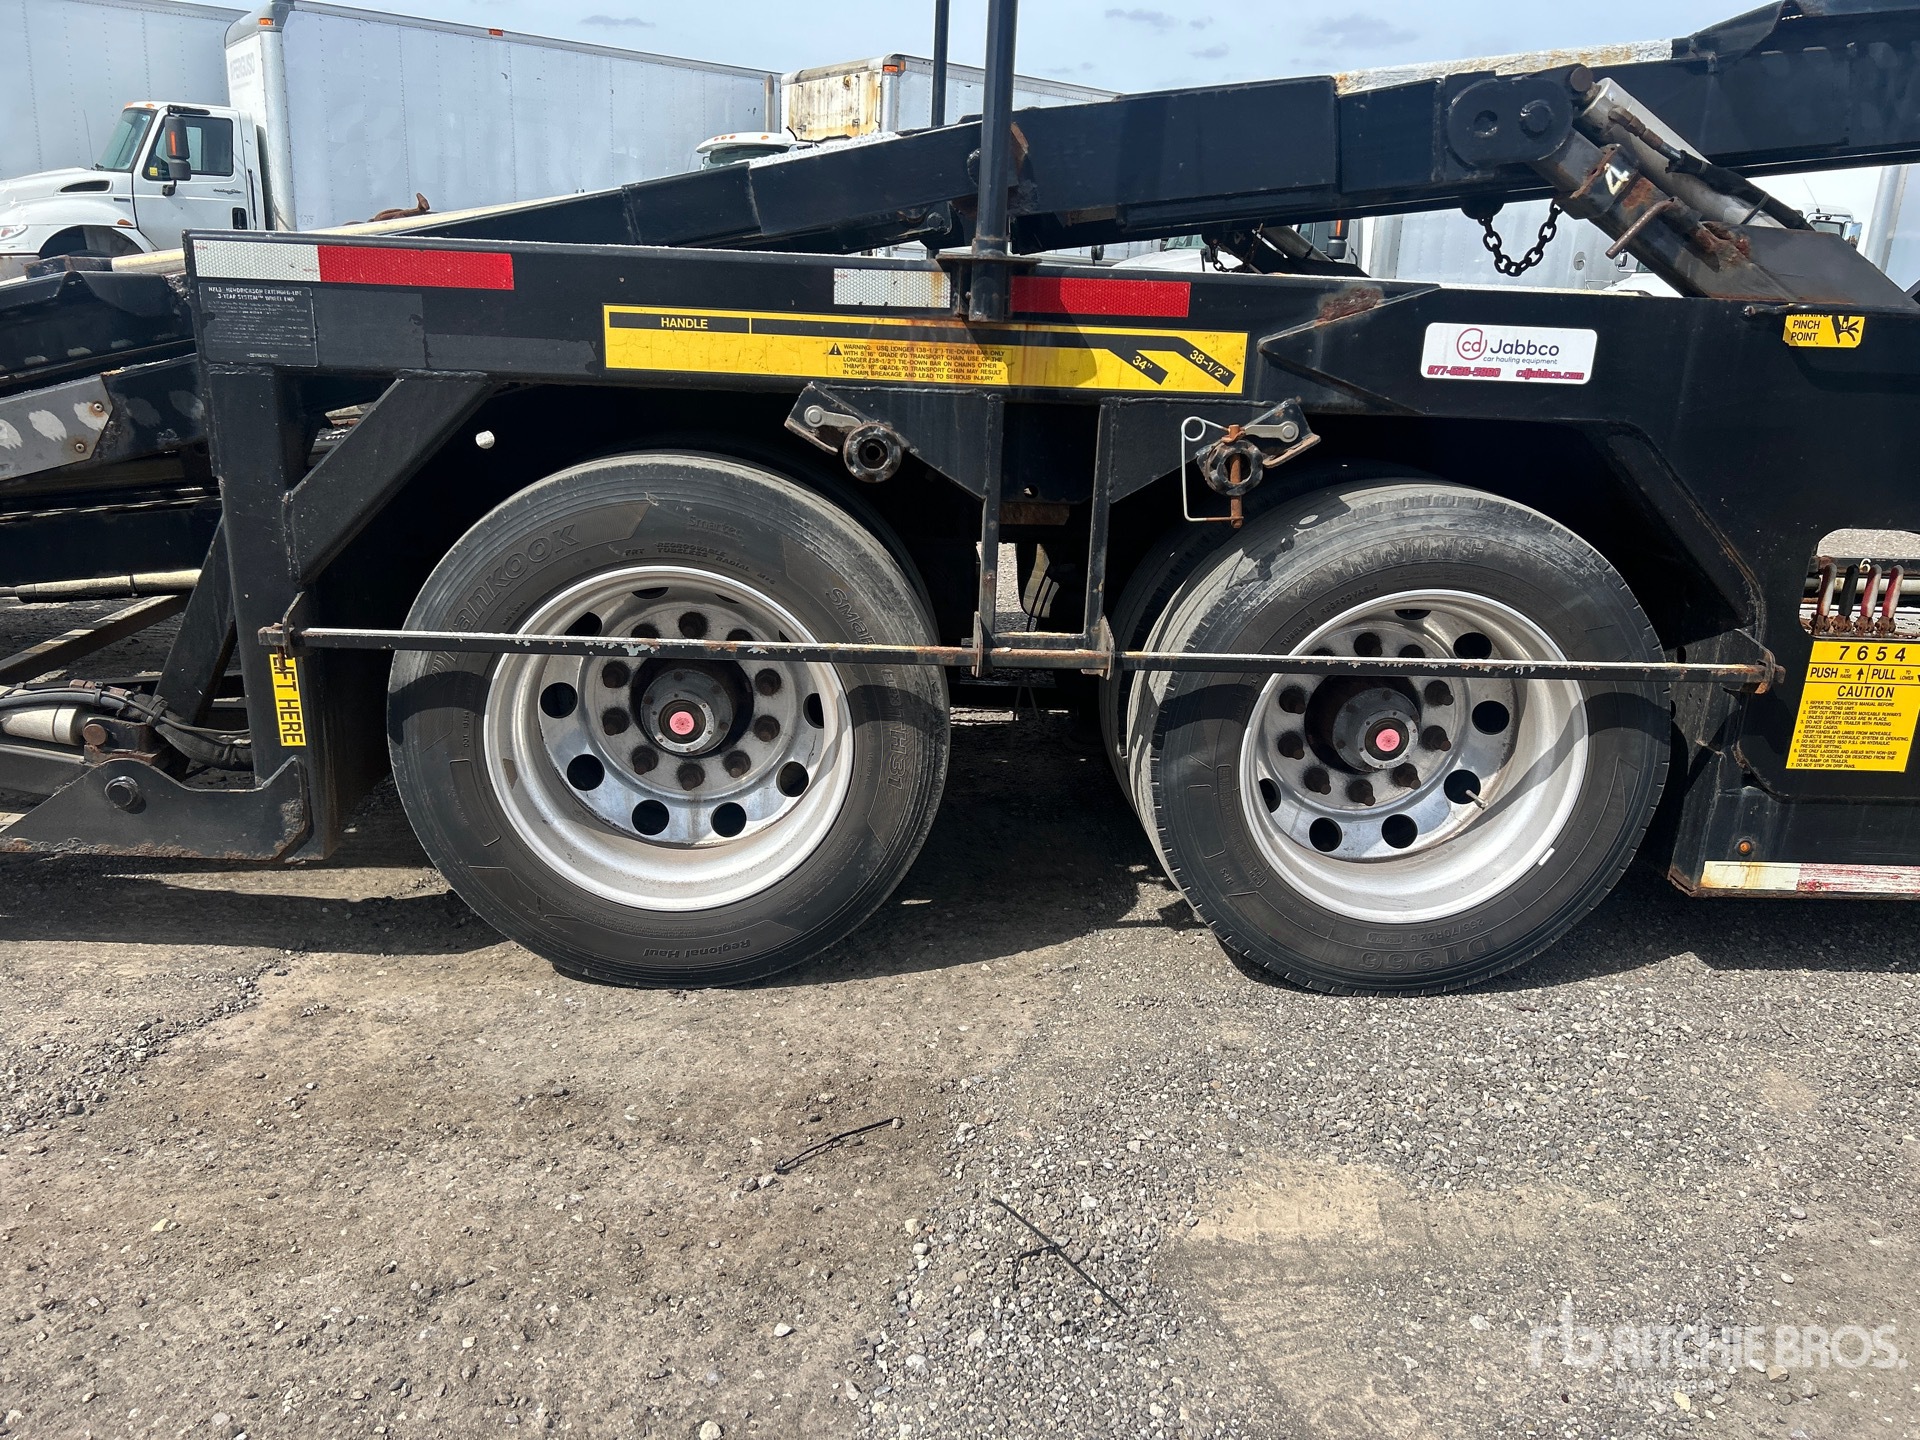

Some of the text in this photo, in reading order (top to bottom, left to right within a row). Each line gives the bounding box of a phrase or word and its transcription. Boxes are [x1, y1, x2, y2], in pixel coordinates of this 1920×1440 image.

[1604, 162, 1630, 196] 4
[661, 317, 708, 329] HANDLE
[1792, 319, 1820, 329] PINCH
[1790, 331, 1818, 341] POINT
[1490, 339, 1560, 356] Jabbco
[1496, 356, 1521, 364] hauling
[1522, 357, 1558, 365] equipment
[656, 541, 727, 557] REGROOVABLE
[657, 547, 708, 558] TUBELESS
[716, 556, 750, 572] RADIAL
[1839, 645, 1906, 662] 7 6 5 4
[1810, 667, 1839, 679] PUSH
[1871, 668, 1896, 680] PULL
[1837, 685, 1895, 698] CAUTION
[278, 699, 304, 743] HERE
[642, 938, 751, 959] Regional Haul
